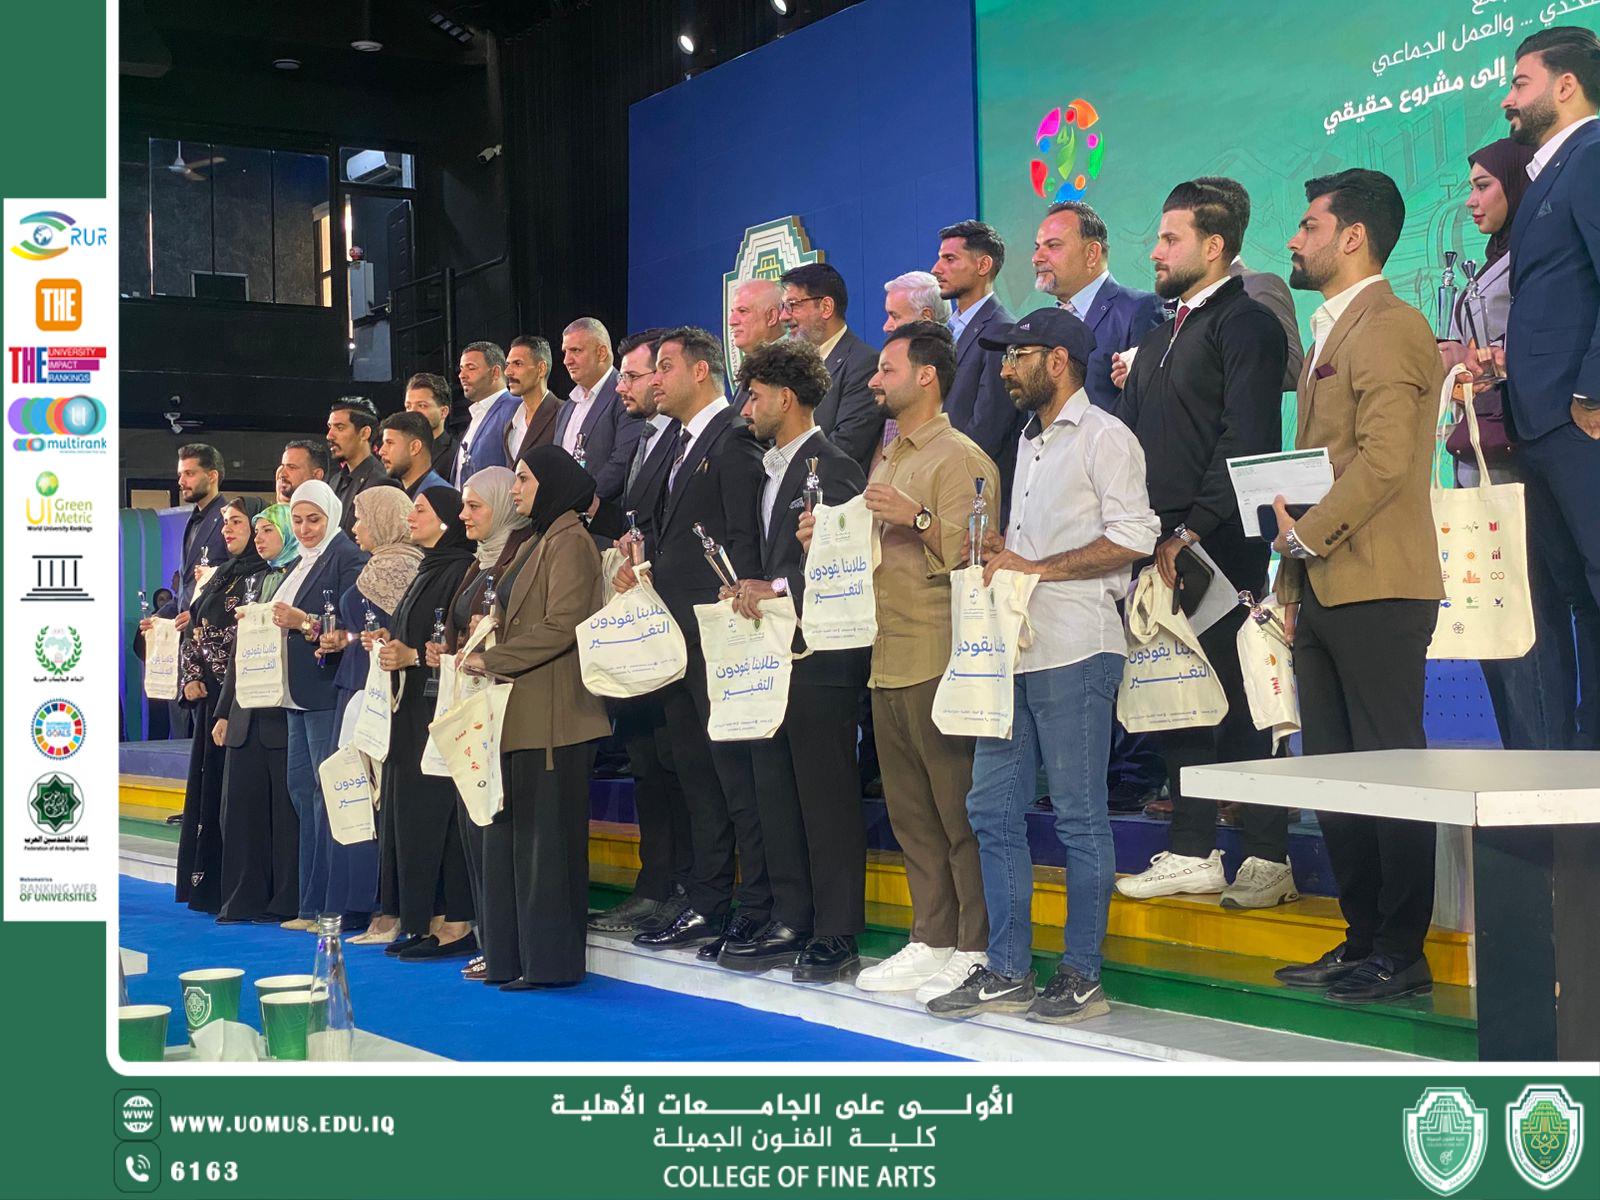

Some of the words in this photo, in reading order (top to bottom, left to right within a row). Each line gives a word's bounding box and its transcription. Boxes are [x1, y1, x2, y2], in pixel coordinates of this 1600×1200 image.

[1452, 13, 1514, 51] والعمل
[1371, 30, 1445, 76] الجماعي
[1470, 56, 1506, 88] إلى
[1399, 69, 1464, 113] مشروع
[1323, 94, 1393, 135] حقيقي
[809, 559, 841, 581] يقودون
[841, 556, 867, 576] طلابنا
[590, 611, 636, 629] يقودون
[589, 620, 670, 649] التغيير
[1128, 642, 1171, 664] يقودون
[1129, 661, 1211, 689] التغيير
[334, 772, 368, 791] قودون
